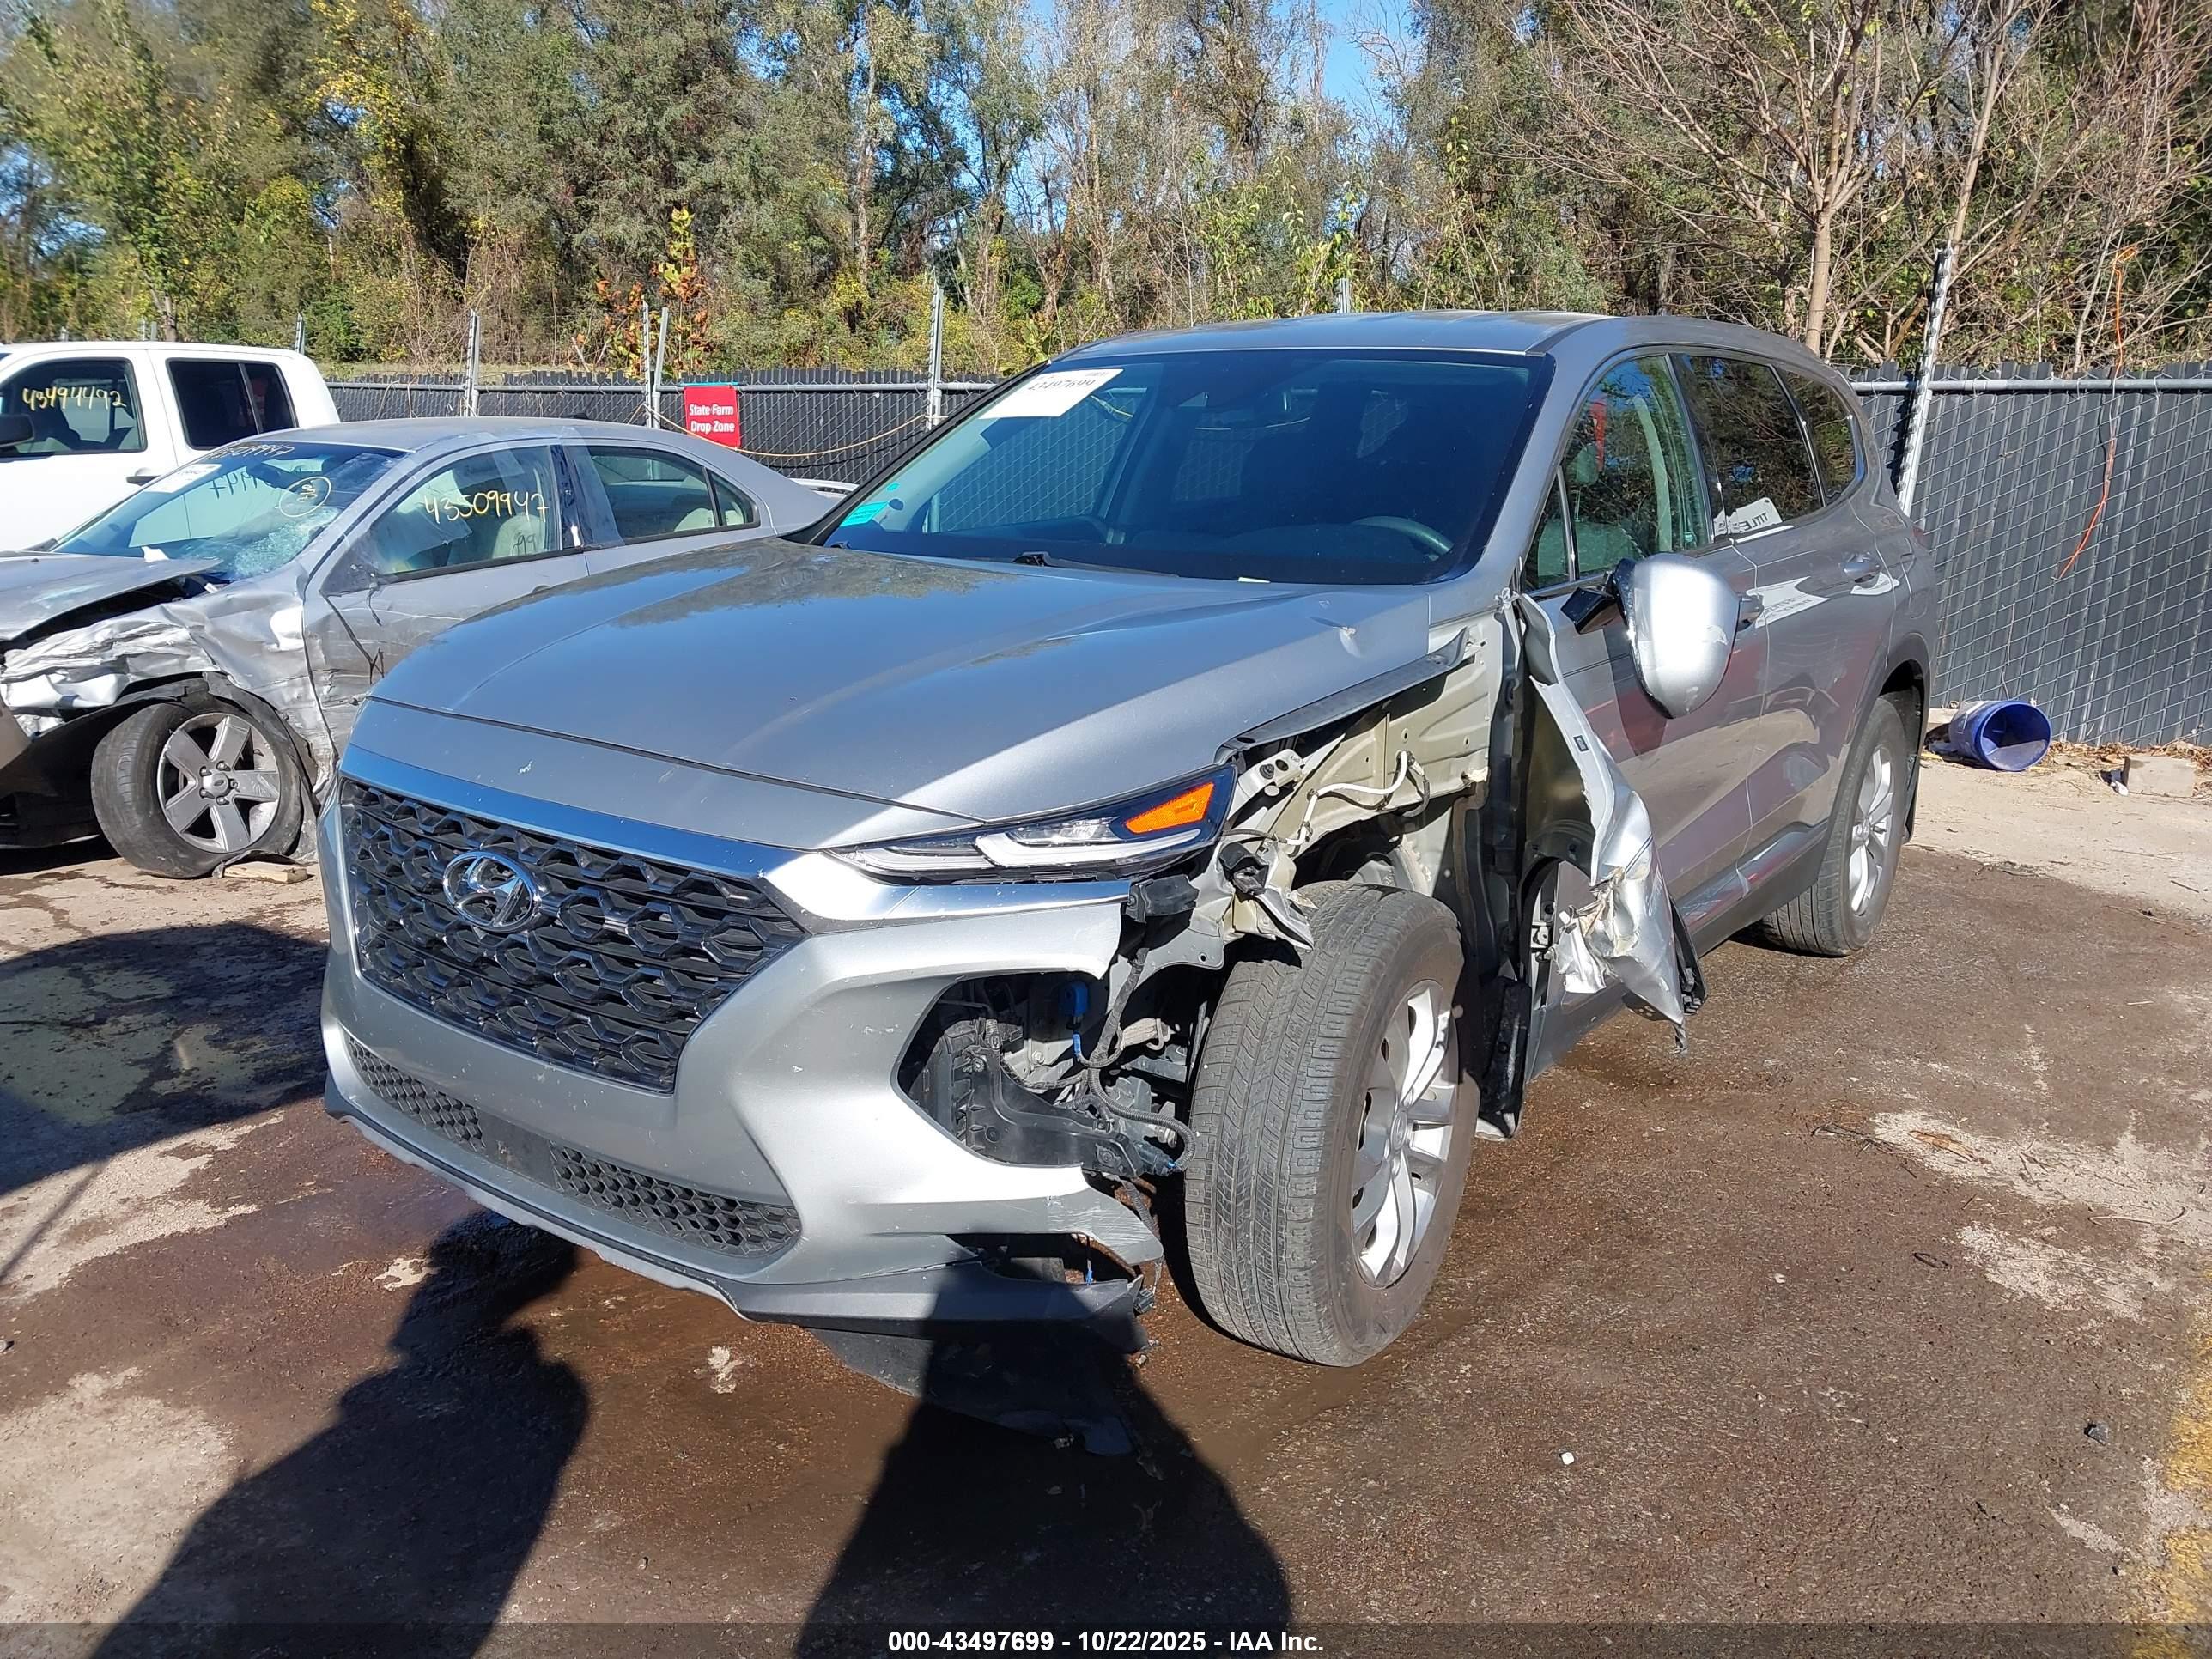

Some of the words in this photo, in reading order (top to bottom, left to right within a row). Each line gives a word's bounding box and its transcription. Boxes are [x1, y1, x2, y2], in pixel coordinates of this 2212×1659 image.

[22, 386, 127, 411] 43494492
[689, 404, 711, 416] State
[712, 404, 734, 416] Farm
[690, 420, 712, 434] Drop
[713, 420, 735, 432] Zone
[424, 490, 550, 524] 43509947
